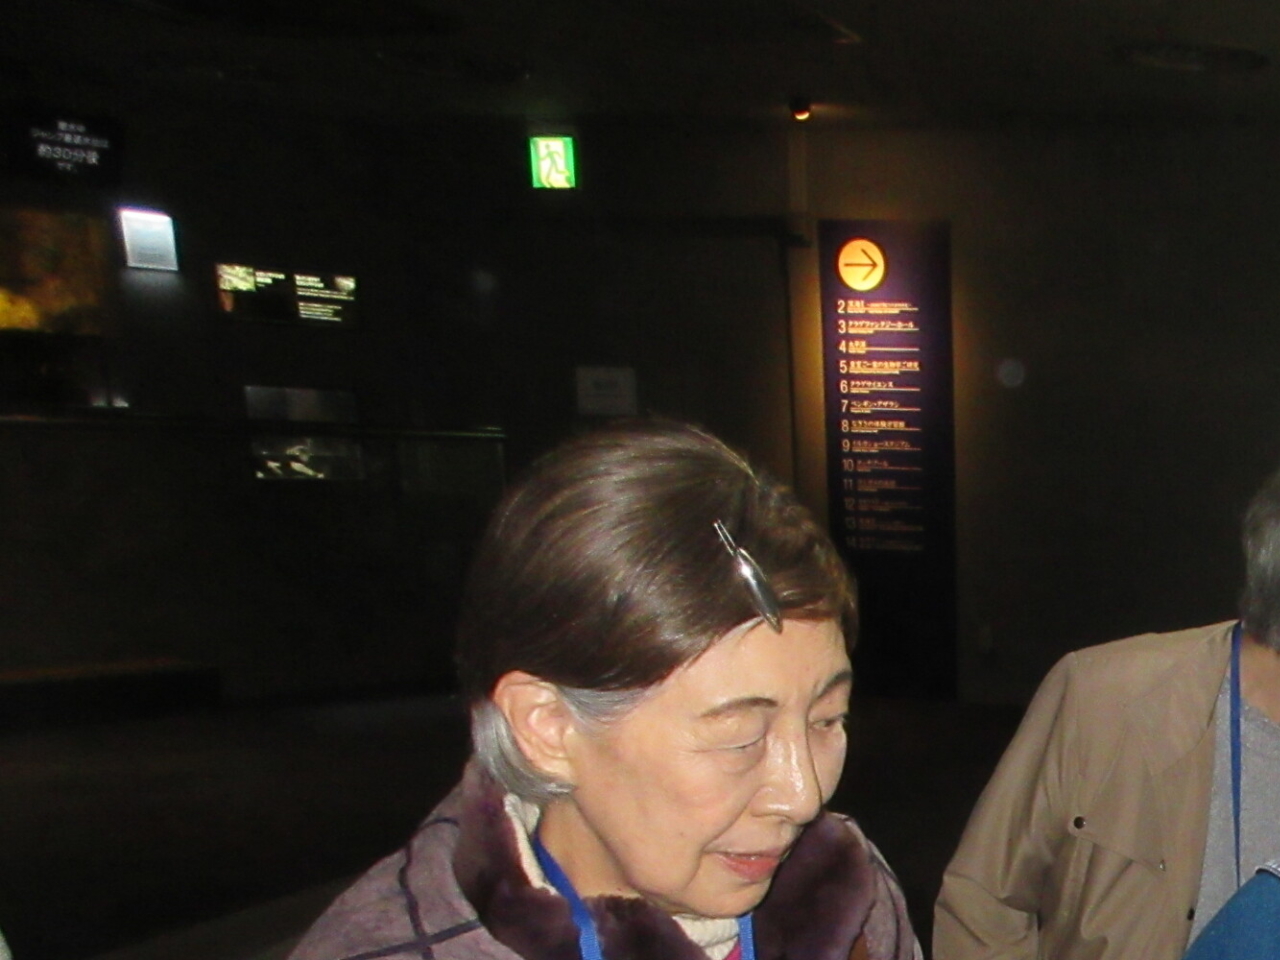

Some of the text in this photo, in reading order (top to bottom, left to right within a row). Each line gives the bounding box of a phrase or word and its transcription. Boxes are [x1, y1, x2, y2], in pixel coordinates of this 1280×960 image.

[837, 299, 846, 314] 2
[838, 319, 847, 334] 3
[838, 340, 847, 354] 4
[839, 360, 848, 374] 5
[840, 379, 848, 394] 6
[840, 399, 849, 413] 7
[841, 418, 850, 433] 8
[842, 438, 851, 452] 9
[842, 458, 854, 472] 10
[843, 478, 854, 491] 11
